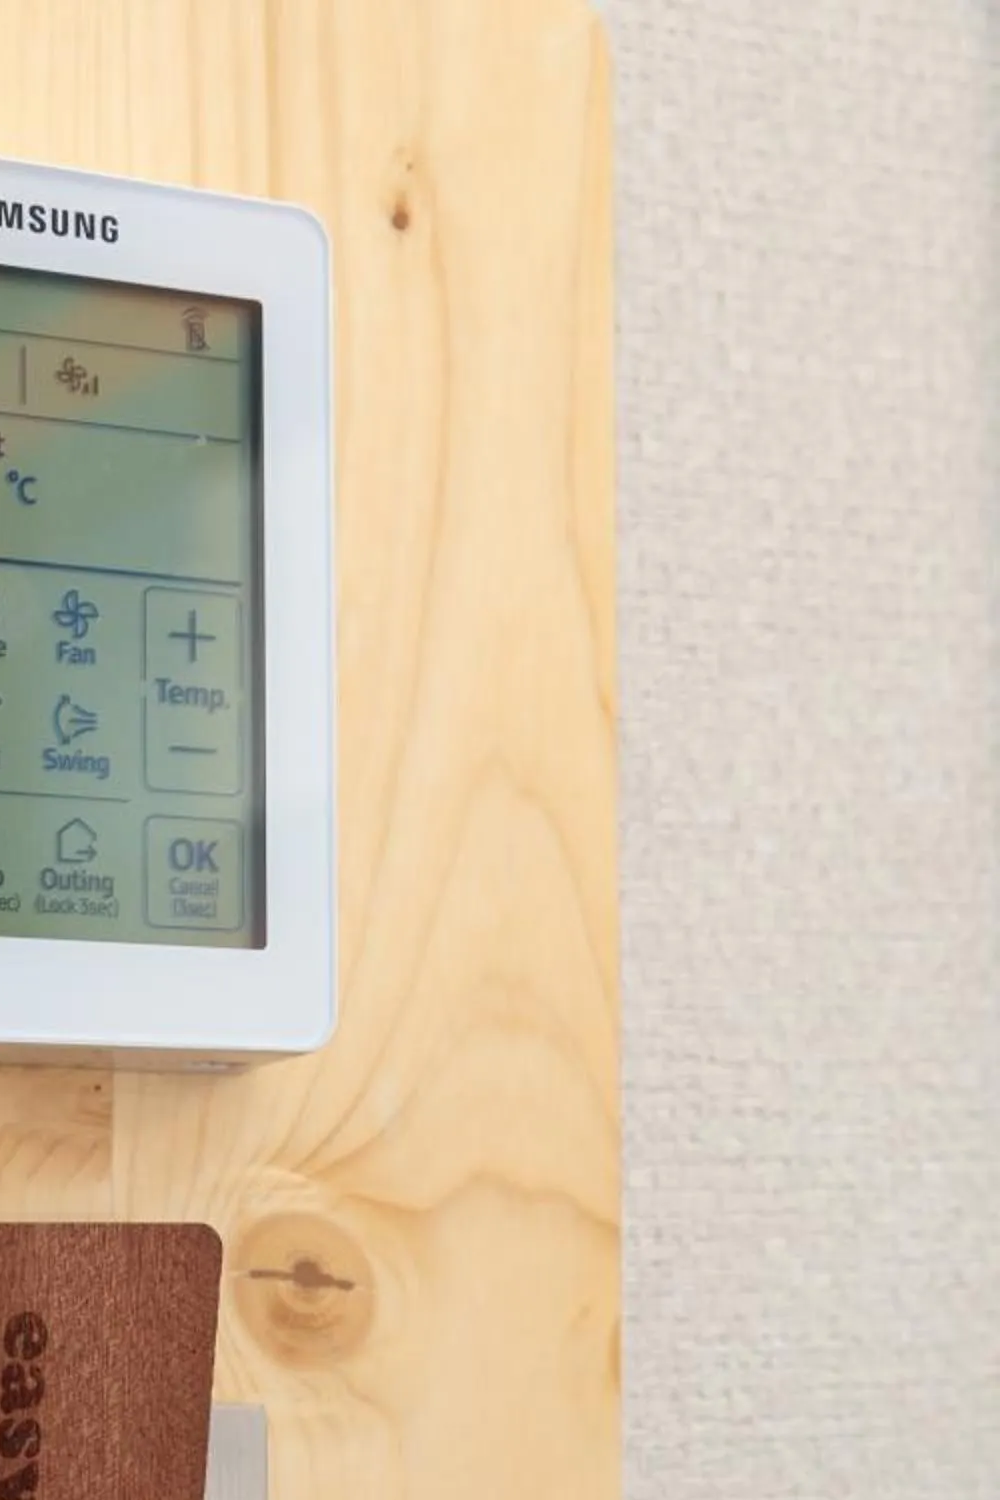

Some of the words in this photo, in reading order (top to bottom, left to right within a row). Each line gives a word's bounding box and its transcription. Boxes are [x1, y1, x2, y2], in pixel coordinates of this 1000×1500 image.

[56, 640, 97, 665] Fan
[155, 677, 230, 713] Temp.
[42, 748, 110, 780] Swing
[169, 837, 220, 873] OK
[40, 867, 115, 898] Outing
